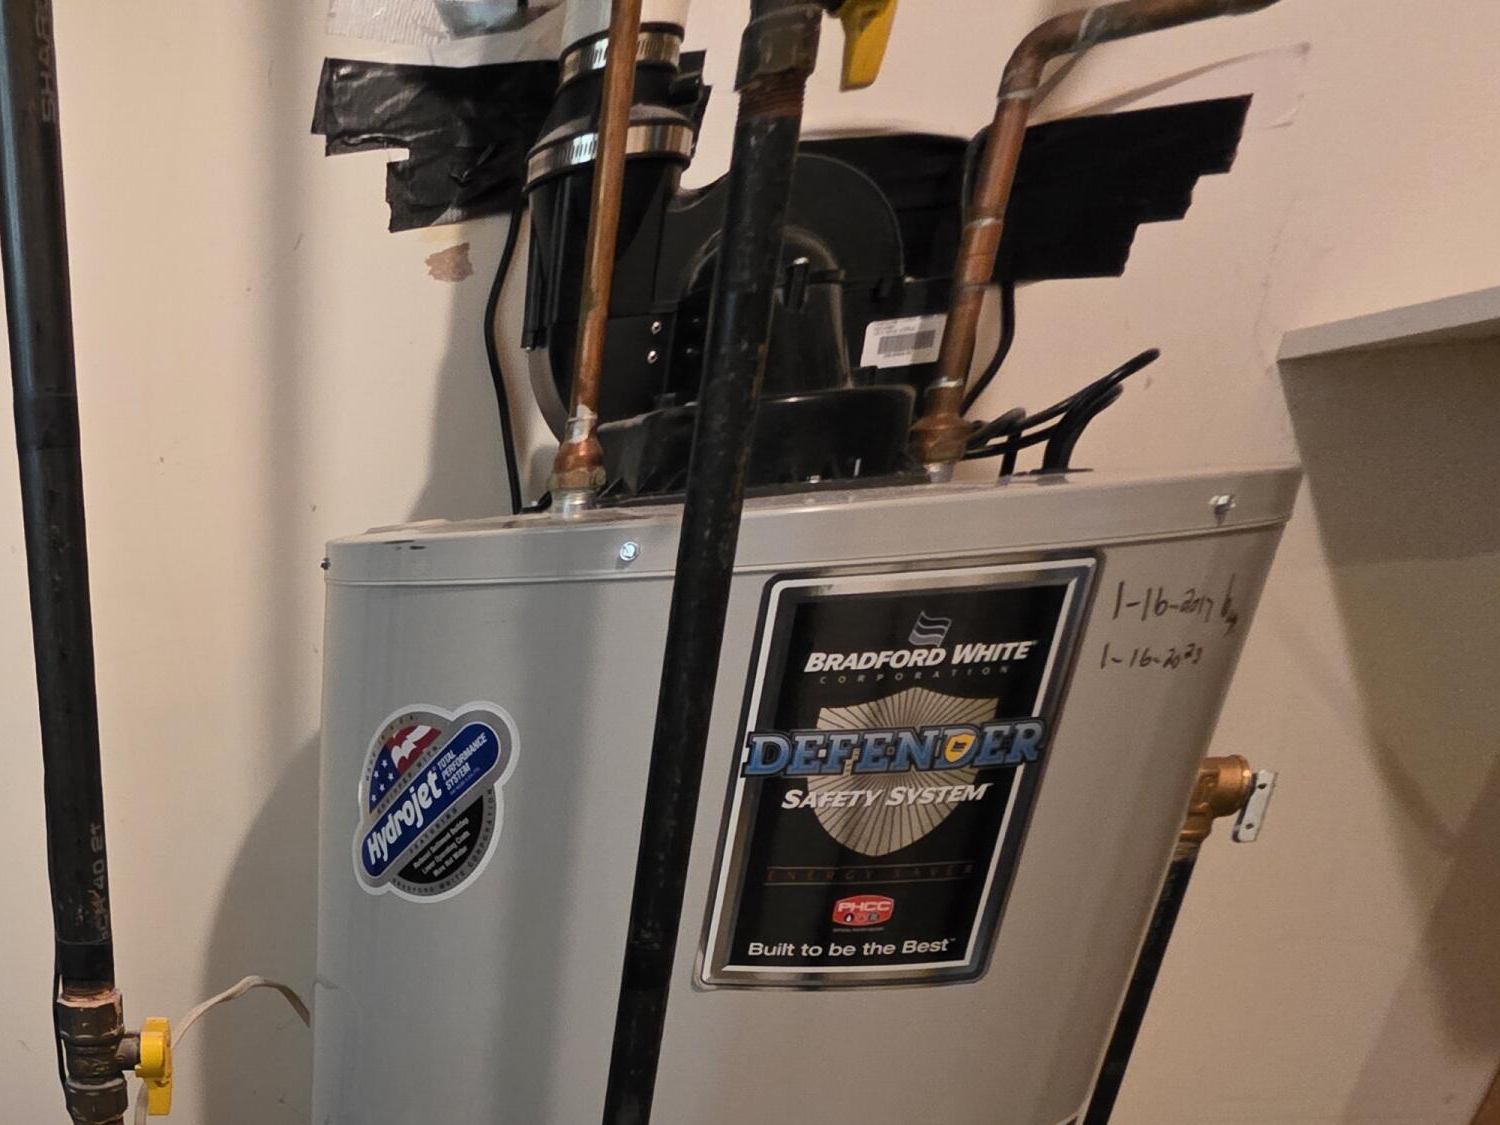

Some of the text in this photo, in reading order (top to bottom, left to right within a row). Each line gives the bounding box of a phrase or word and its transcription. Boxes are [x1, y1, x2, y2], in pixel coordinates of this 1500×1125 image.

[804, 640, 1034, 672] BRADFORD WHITE
[820, 667, 1009, 684] CORPORATION
[437, 749, 457, 770] TOTAL
[441, 732, 488, 780] PERFORMANCE
[743, 718, 1046, 778] DEFENDER
[445, 762, 472, 791] SYSTEM
[782, 783, 990, 809] SAFETY SYSTEM
[366, 770, 442, 865] Hydrojet
[837, 900, 891, 914] PHCC
[748, 938, 948, 957] Built to be the Best
